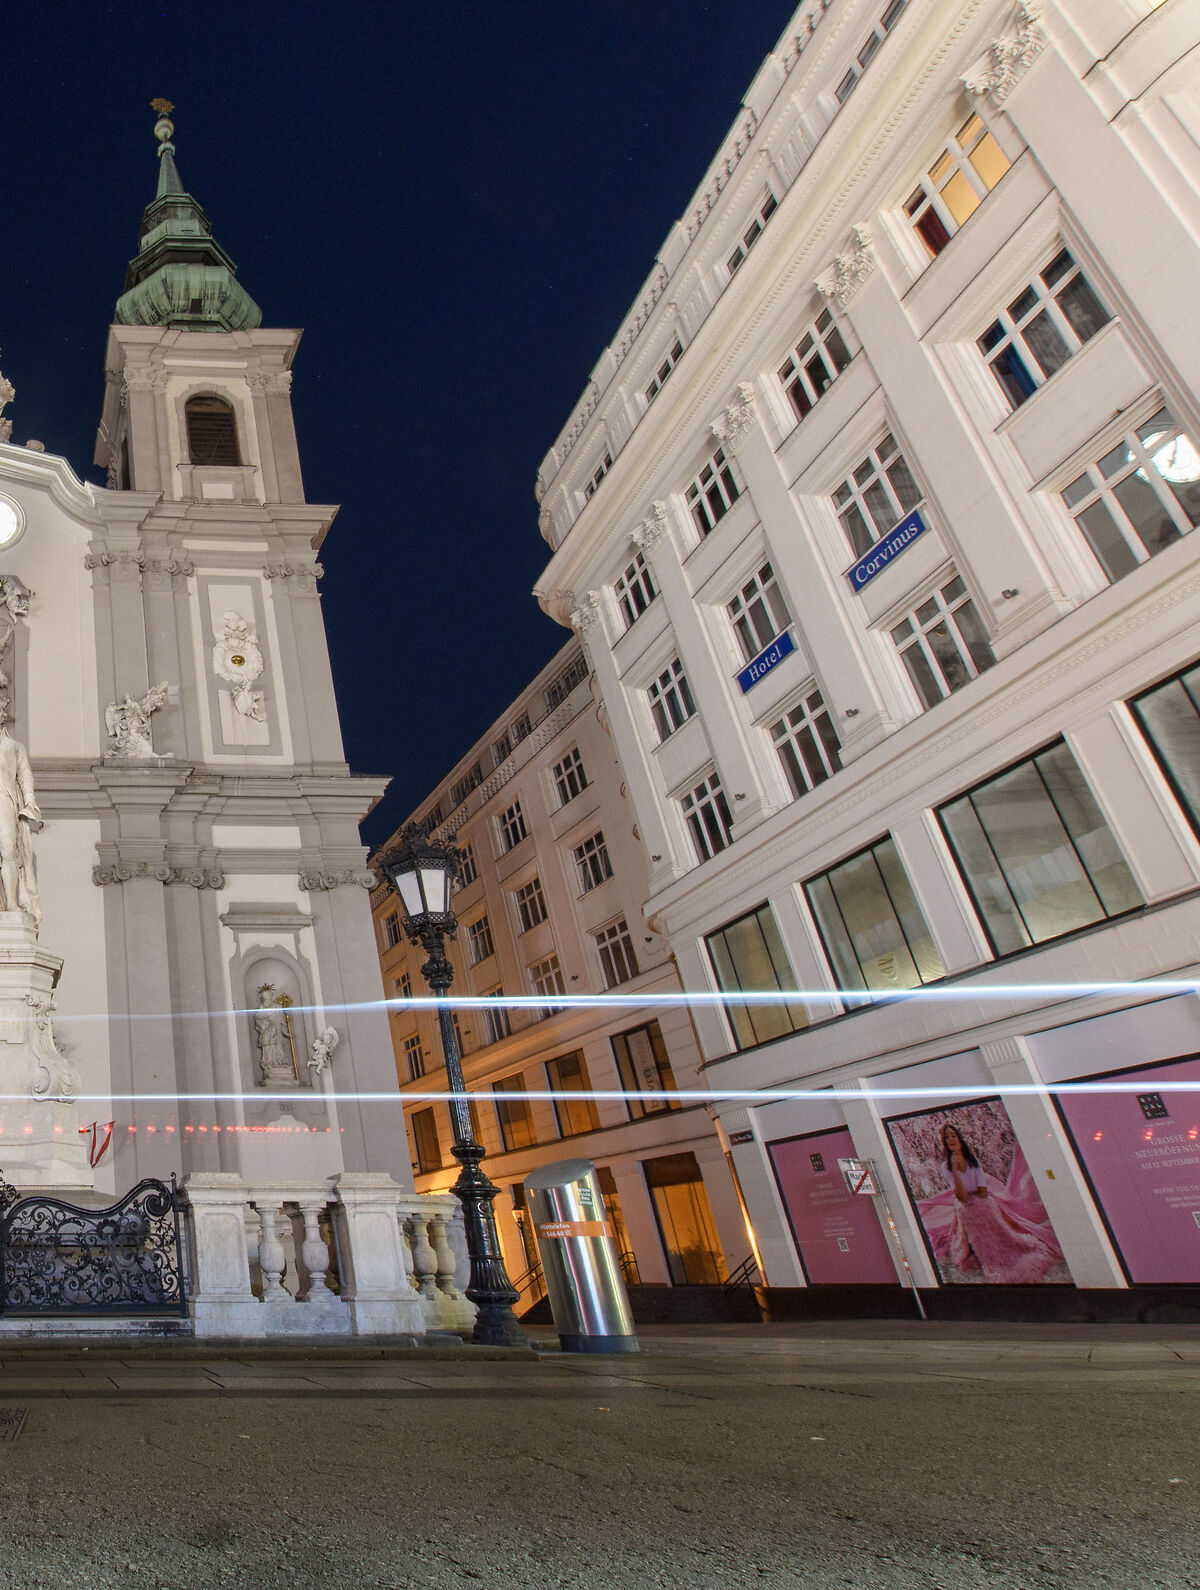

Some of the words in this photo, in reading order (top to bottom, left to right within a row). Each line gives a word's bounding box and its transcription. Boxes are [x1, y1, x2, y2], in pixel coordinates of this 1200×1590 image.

[855, 522, 918, 583] Corvinus
[748, 644, 783, 682] Hotel
[1150, 1134, 1185, 1146] GROSSE
